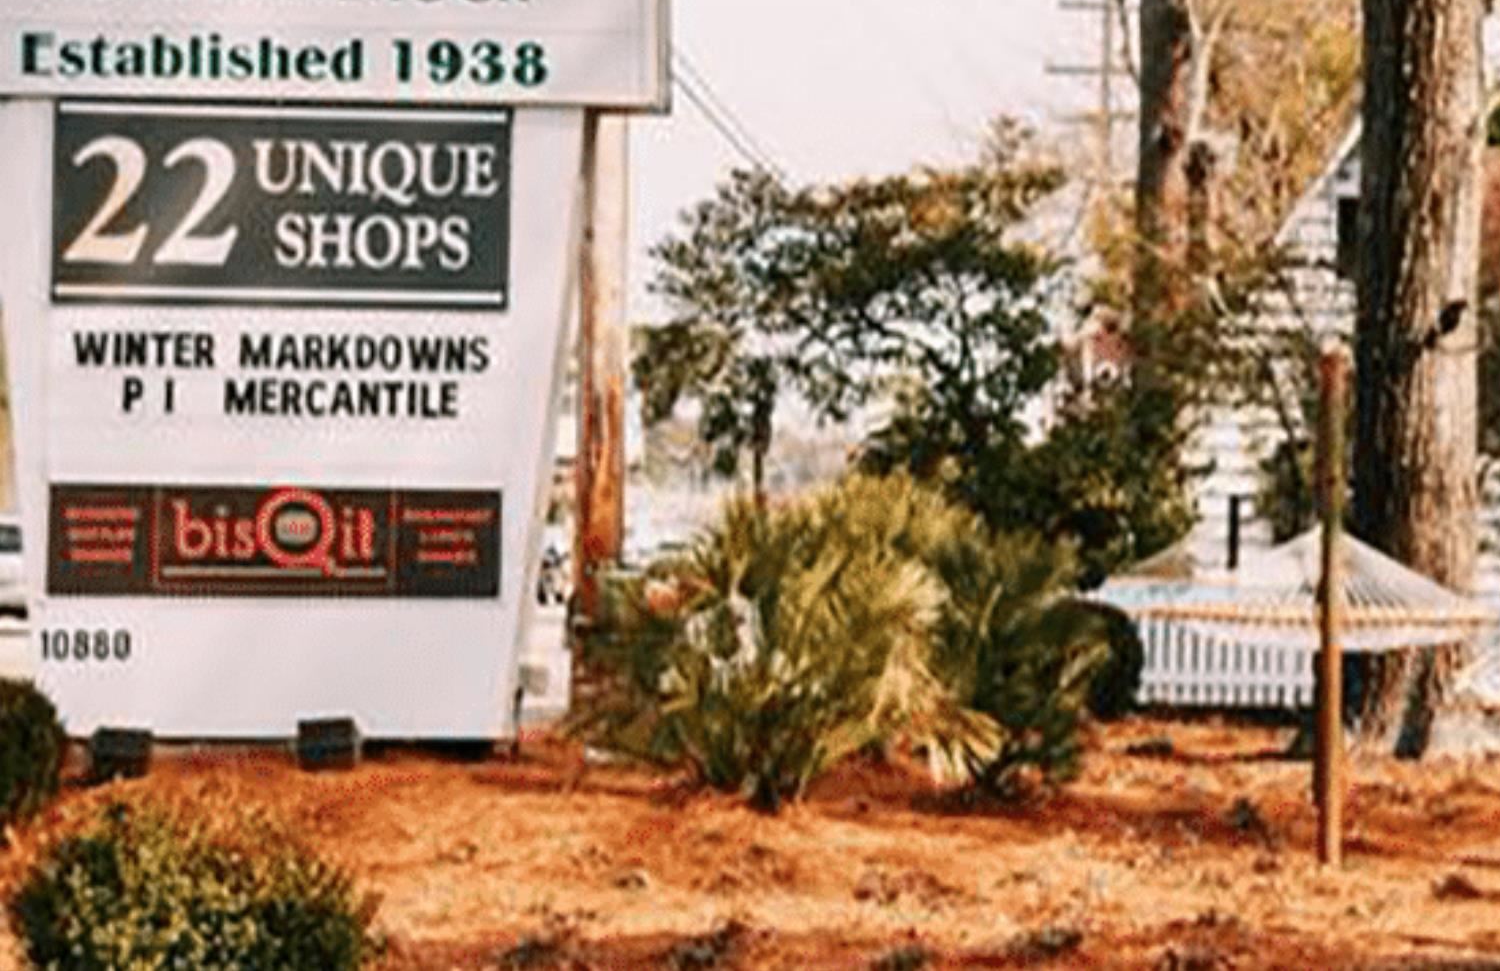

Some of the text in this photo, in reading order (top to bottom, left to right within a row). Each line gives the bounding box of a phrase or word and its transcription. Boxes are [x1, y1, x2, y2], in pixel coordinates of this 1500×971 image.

[21, 31, 548, 86] Established 1938
[61, 136, 499, 266] 22 UNIQUE
[274, 214, 470, 270] SHOPS
[73, 332, 490, 372] WINTER MARKDOWNS
[122, 381, 142, 412] P
[224, 381, 458, 418] MERCANTILE
[41, 629, 131, 661] 10880
